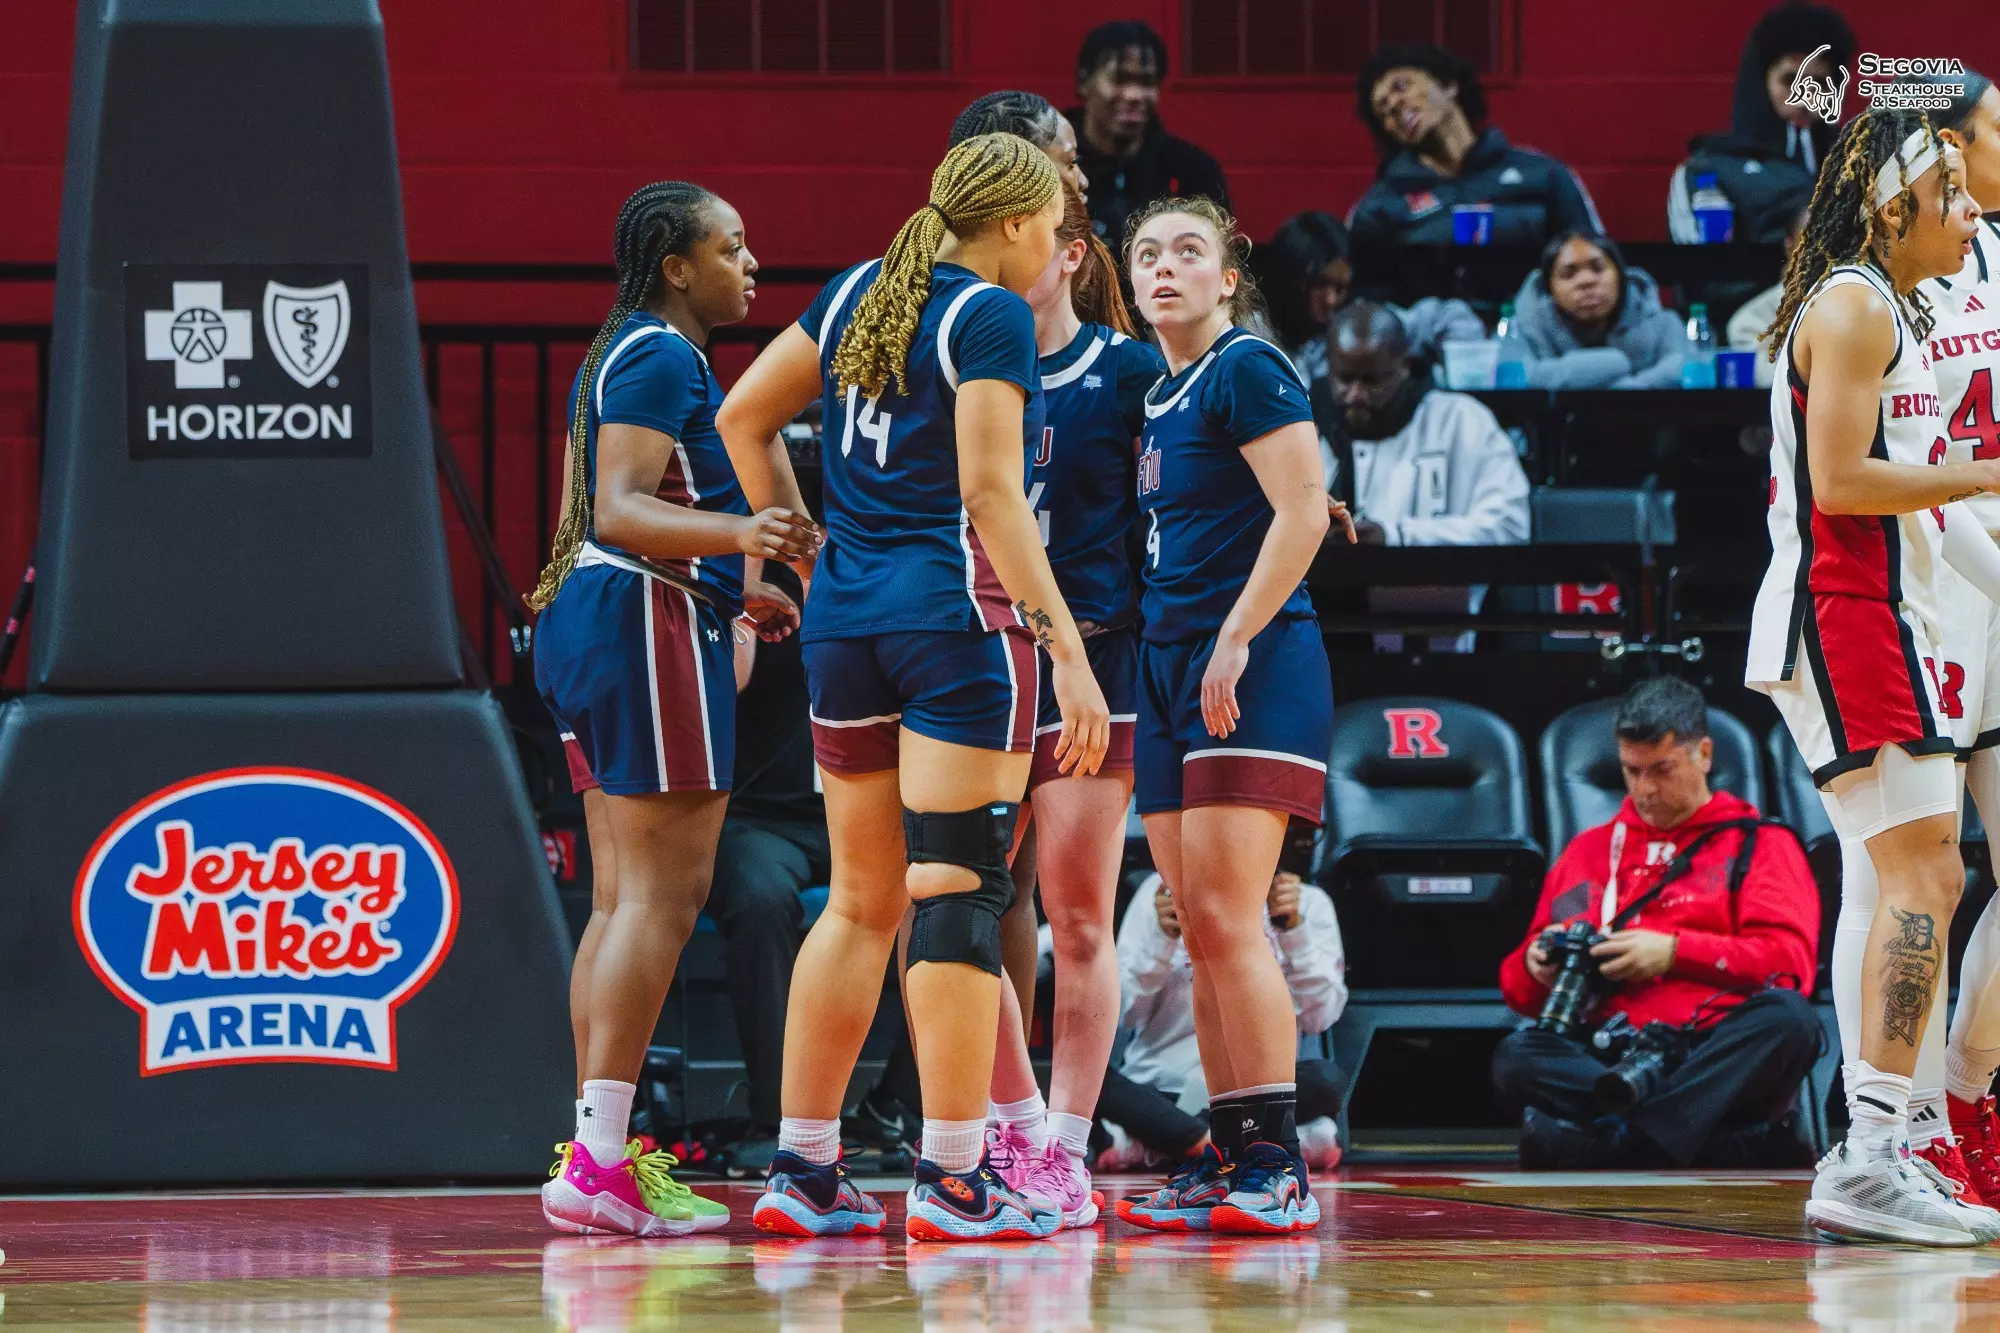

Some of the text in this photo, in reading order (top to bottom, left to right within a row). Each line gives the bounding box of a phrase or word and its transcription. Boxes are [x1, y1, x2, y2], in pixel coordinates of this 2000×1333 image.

[1931, 328, 2000, 363] RUTG
[147, 403, 353, 441] HORIZON
[841, 383, 892, 469] 14
[1891, 392, 1944, 420] RUTG
[1384, 708, 1449, 759] R
[130, 823, 402, 917] Jersey
[146, 898, 398, 975] Mike's
[160, 1003, 377, 1060] ARENA
